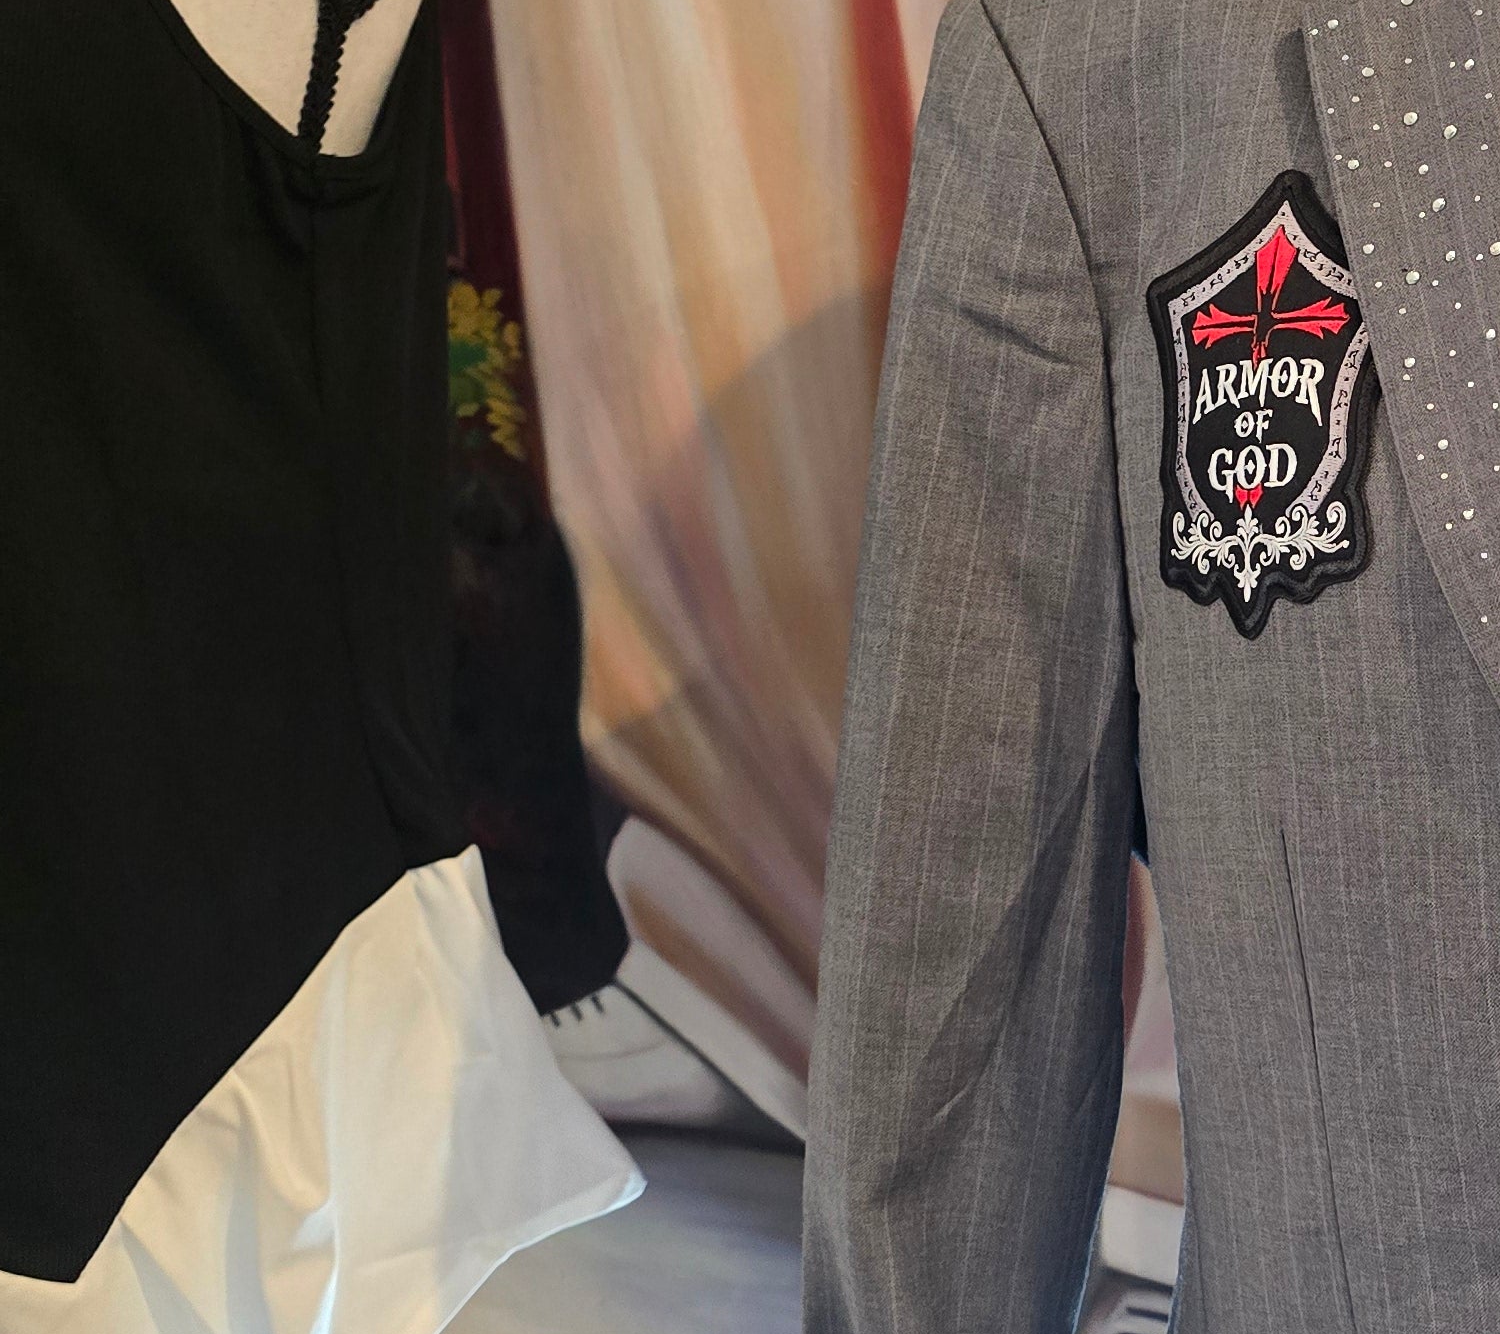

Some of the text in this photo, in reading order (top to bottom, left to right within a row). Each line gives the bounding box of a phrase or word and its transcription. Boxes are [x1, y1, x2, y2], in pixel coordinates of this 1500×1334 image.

[1192, 355, 1325, 427] ARMOR
[1233, 407, 1272, 444] OF
[1207, 442, 1298, 504] GOD
